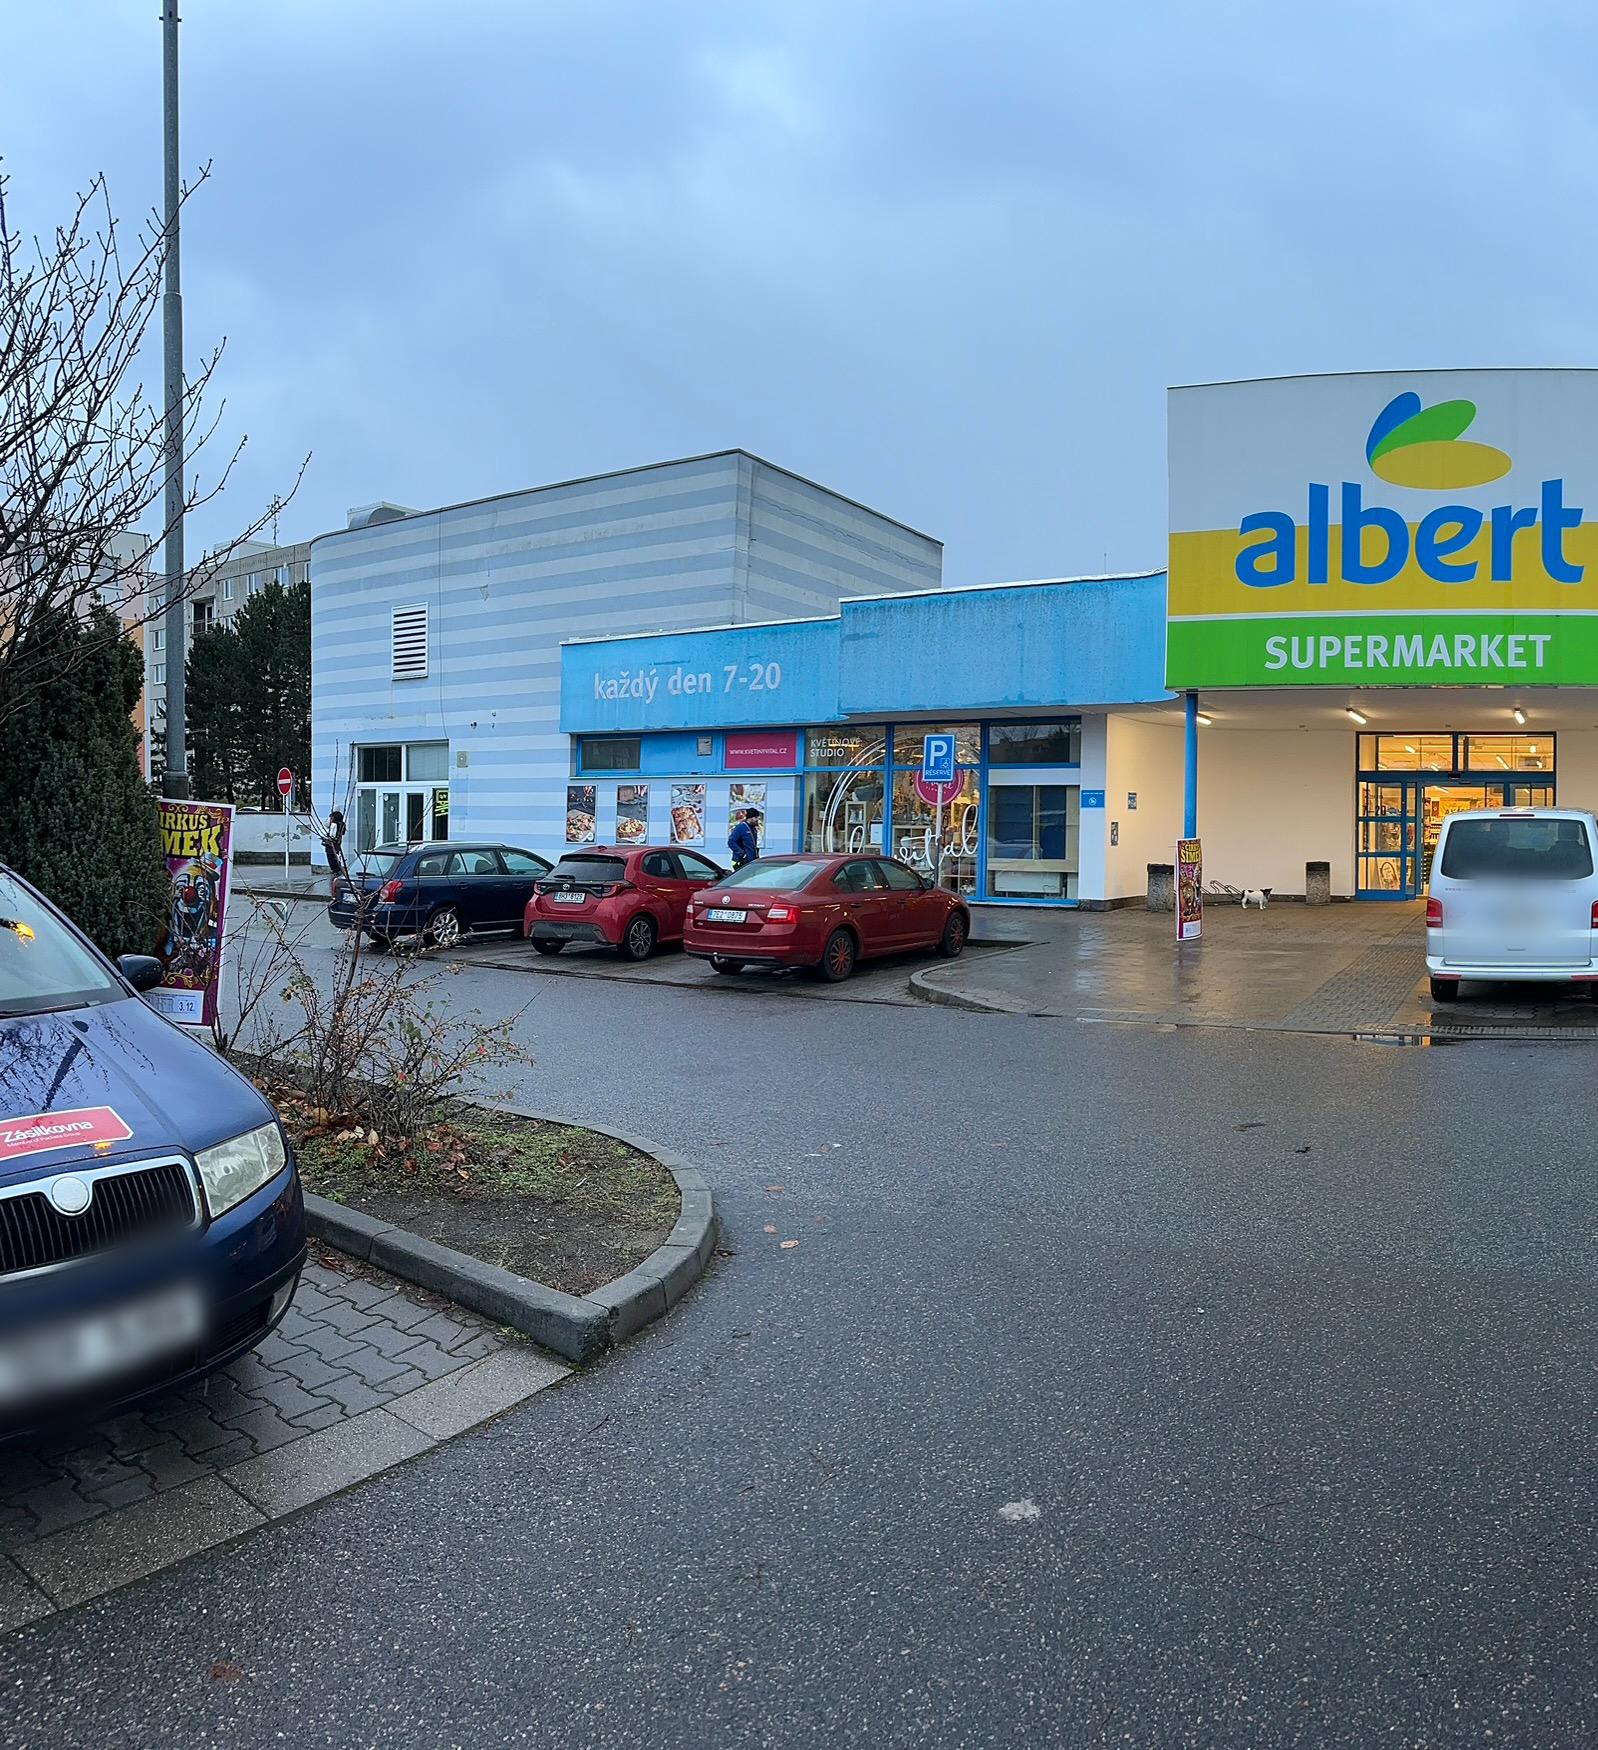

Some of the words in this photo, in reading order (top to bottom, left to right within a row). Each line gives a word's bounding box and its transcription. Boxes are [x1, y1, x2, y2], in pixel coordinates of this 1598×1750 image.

[1235, 478, 1585, 588] albert
[1264, 634, 1552, 670] SUPERMARKET
[594, 667, 660, 704] každý
[668, 666, 712, 696] den
[723, 662, 782, 693] 7-20
[809, 747, 845, 758] STUDIO
[930, 740, 948, 767] P
[160, 811, 209, 831] IRKUS
[160, 824, 221, 857] MEK
[4, 1121, 94, 1143] Zásilkovna
